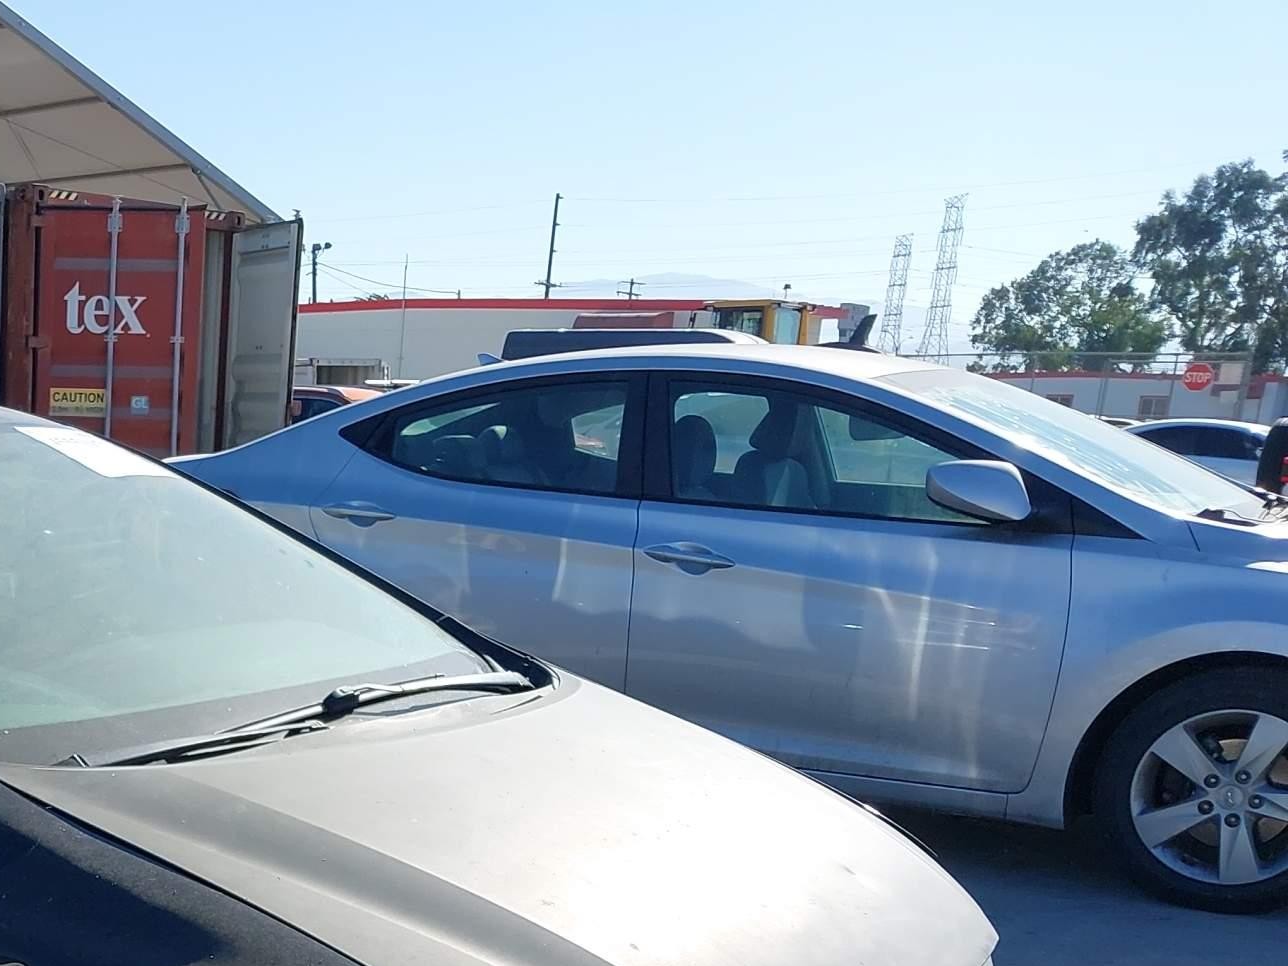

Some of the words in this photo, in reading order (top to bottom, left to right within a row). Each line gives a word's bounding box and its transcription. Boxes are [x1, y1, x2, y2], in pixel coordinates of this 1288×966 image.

[64, 281, 147, 334] tex
[1184, 372, 1212, 383] STOP
[52, 392, 105, 403] CAUTION
[132, 397, 149, 408] GL
